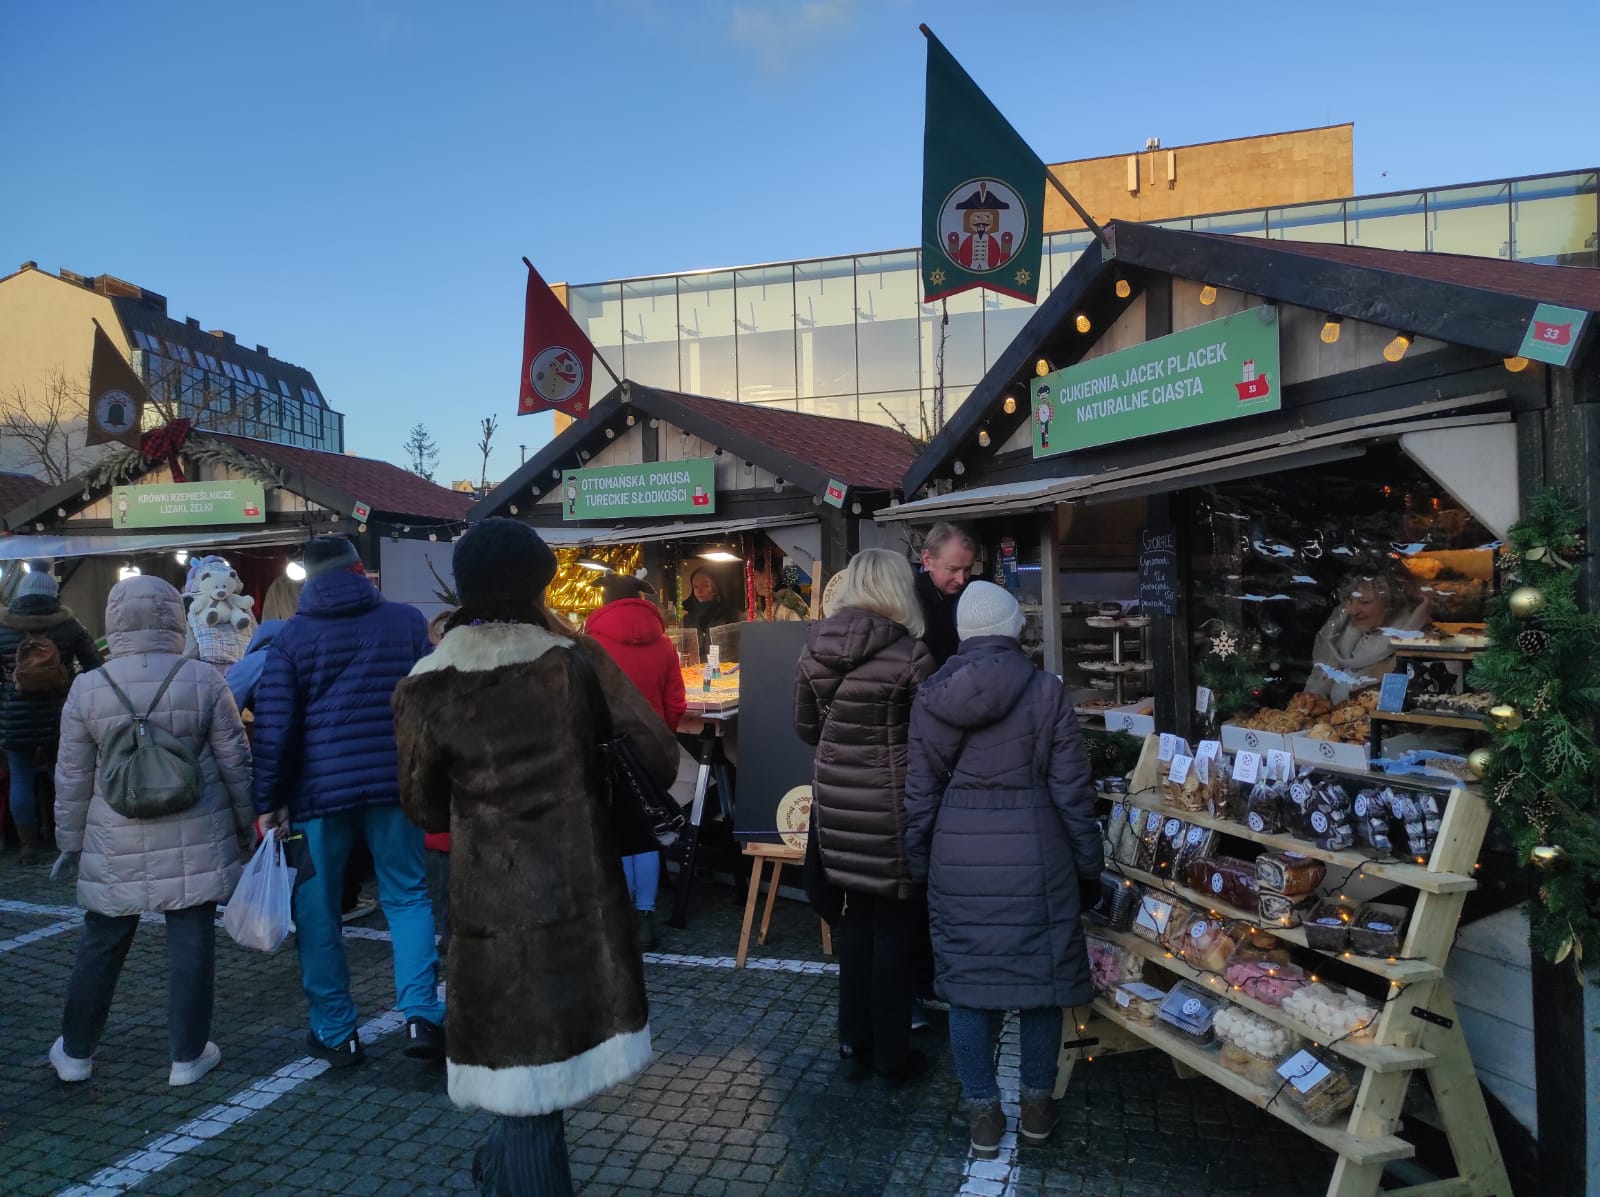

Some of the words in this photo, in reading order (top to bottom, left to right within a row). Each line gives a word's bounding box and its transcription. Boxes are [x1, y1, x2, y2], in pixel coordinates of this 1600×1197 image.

[1543, 327, 1559, 340] 33
[1060, 373, 1119, 405] CUKIERNIA
[1121, 359, 1164, 386] JACEK
[1167, 341, 1228, 373] PLACEK
[1076, 390, 1149, 424] NATURALNE
[1152, 376, 1204, 405] CIASTA
[581, 473, 645, 491] OTTOMAŃSKA
[650, 471, 691, 485] POKUSA
[138, 493, 169, 504] KRÓWKI
[585, 492, 630, 506] TURECKIE
[631, 487, 687, 504] SŁODKOŚCI
[190, 502, 213, 513] ŻELKI
